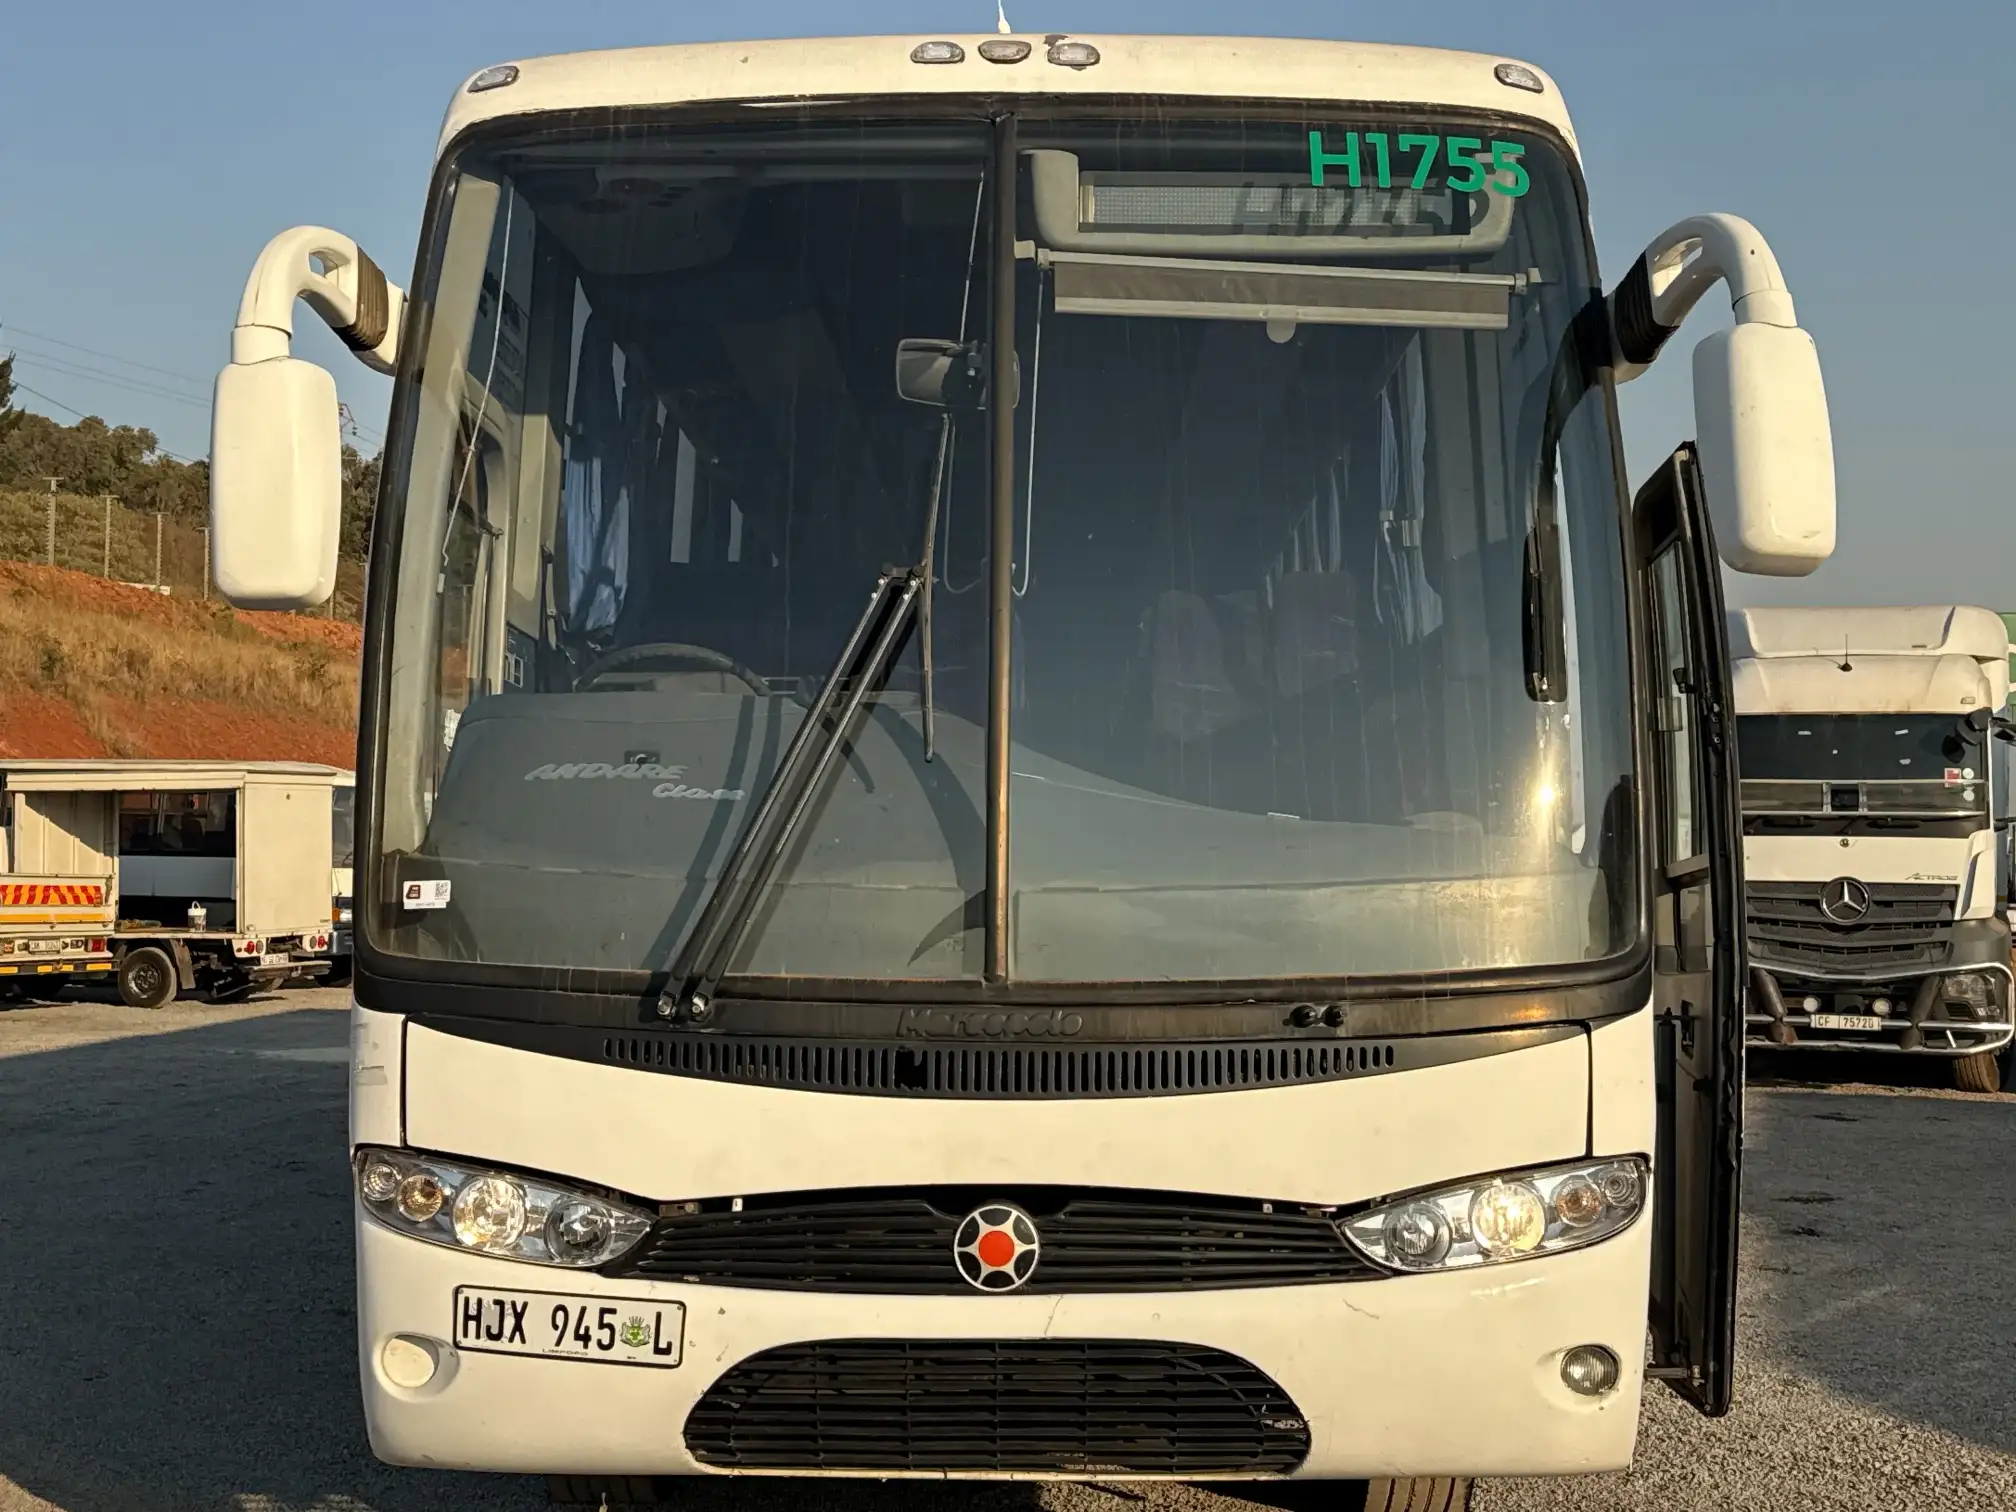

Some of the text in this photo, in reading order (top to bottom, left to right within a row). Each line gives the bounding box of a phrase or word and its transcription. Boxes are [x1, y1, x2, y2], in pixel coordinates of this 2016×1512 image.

[1309, 131, 1530, 197] H1755
[1817, 1015, 1875, 1029] CF 75720
[462, 1296, 673, 1356] HJX 945 L
